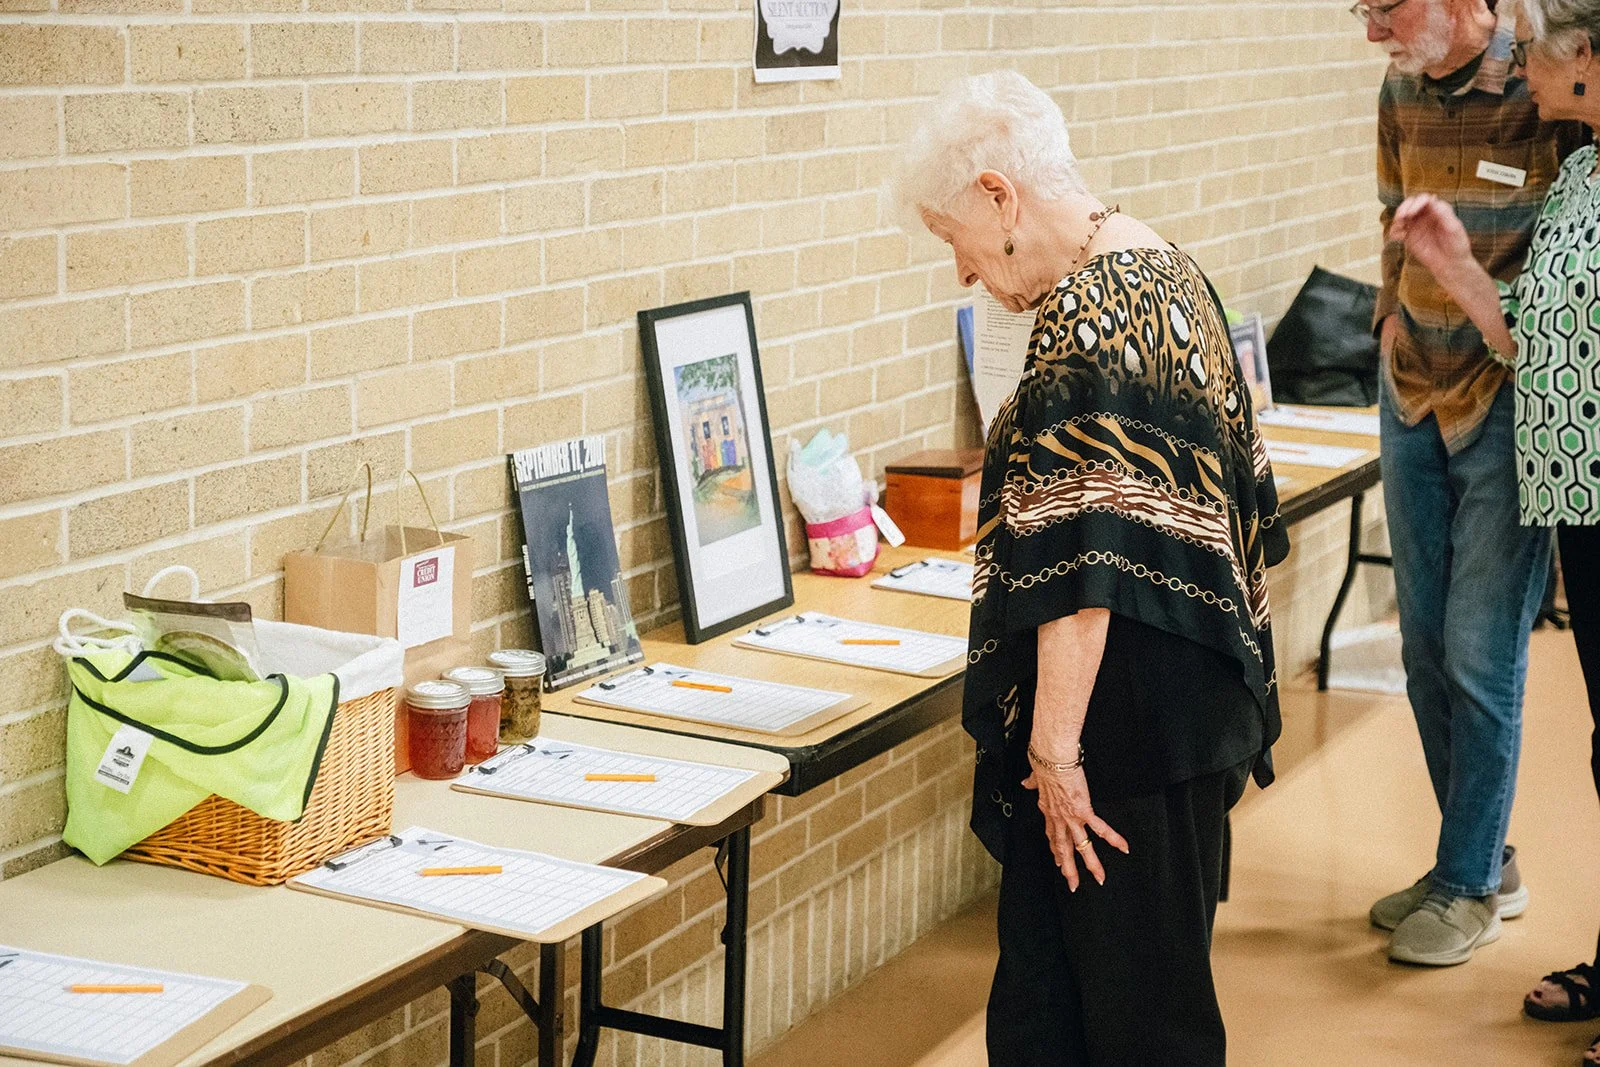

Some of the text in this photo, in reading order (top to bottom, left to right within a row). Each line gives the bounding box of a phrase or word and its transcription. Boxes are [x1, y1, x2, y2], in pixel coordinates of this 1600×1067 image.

[513, 442, 571, 483] SEPTEMBER
[569, 440, 584, 474] 11,
[583, 434, 606, 469] 2001
[416, 565, 436, 578] CREDIT
[417, 574, 435, 584] UNION
